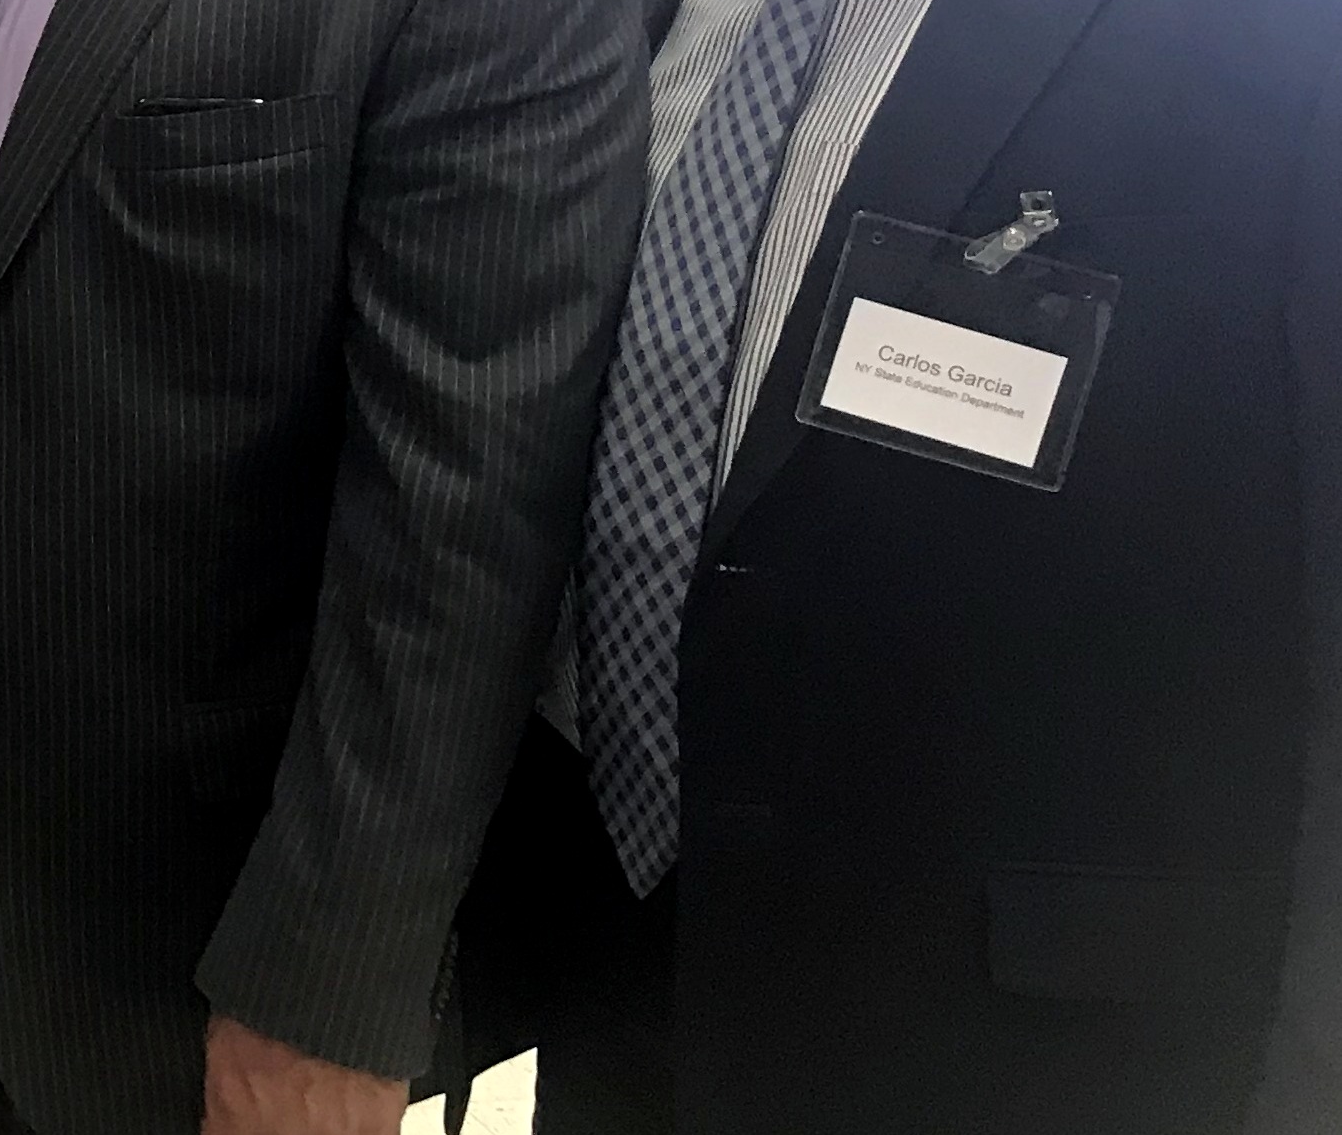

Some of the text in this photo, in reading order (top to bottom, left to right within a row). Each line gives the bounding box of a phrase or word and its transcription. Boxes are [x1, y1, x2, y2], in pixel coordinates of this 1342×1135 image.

[855, 362, 1025, 419] NY State Education Department
[878, 345, 1013, 397] Carlos Garcia
